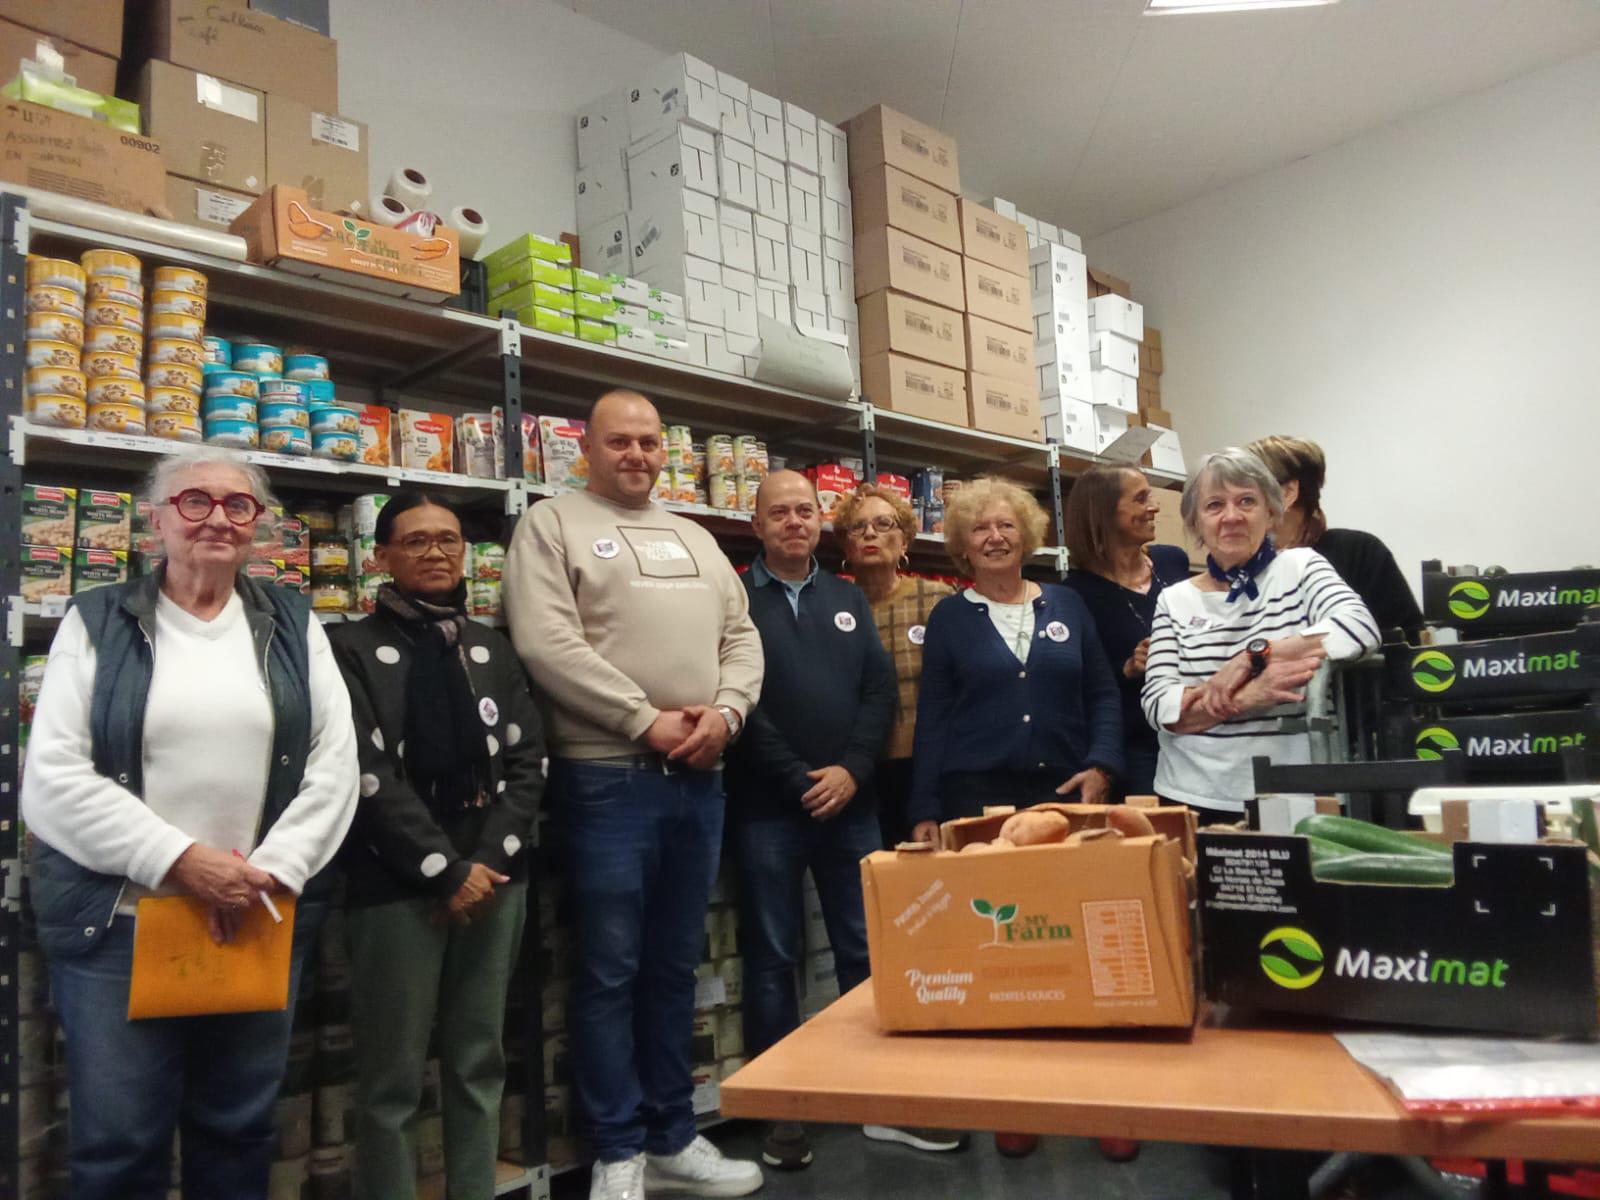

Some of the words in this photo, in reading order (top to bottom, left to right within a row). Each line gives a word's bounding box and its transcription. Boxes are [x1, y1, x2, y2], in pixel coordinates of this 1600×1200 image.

[120, 135, 161, 154] 00902
[1496, 586, 1600, 608] Maxima
[1462, 649, 1581, 679] Maximat
[1023, 914, 1048, 925] MY
[1005, 921, 1073, 942] Farm
[904, 968, 974, 988] Premium
[1335, 947, 1510, 988] Maximat
[916, 983, 967, 1006] Quality
